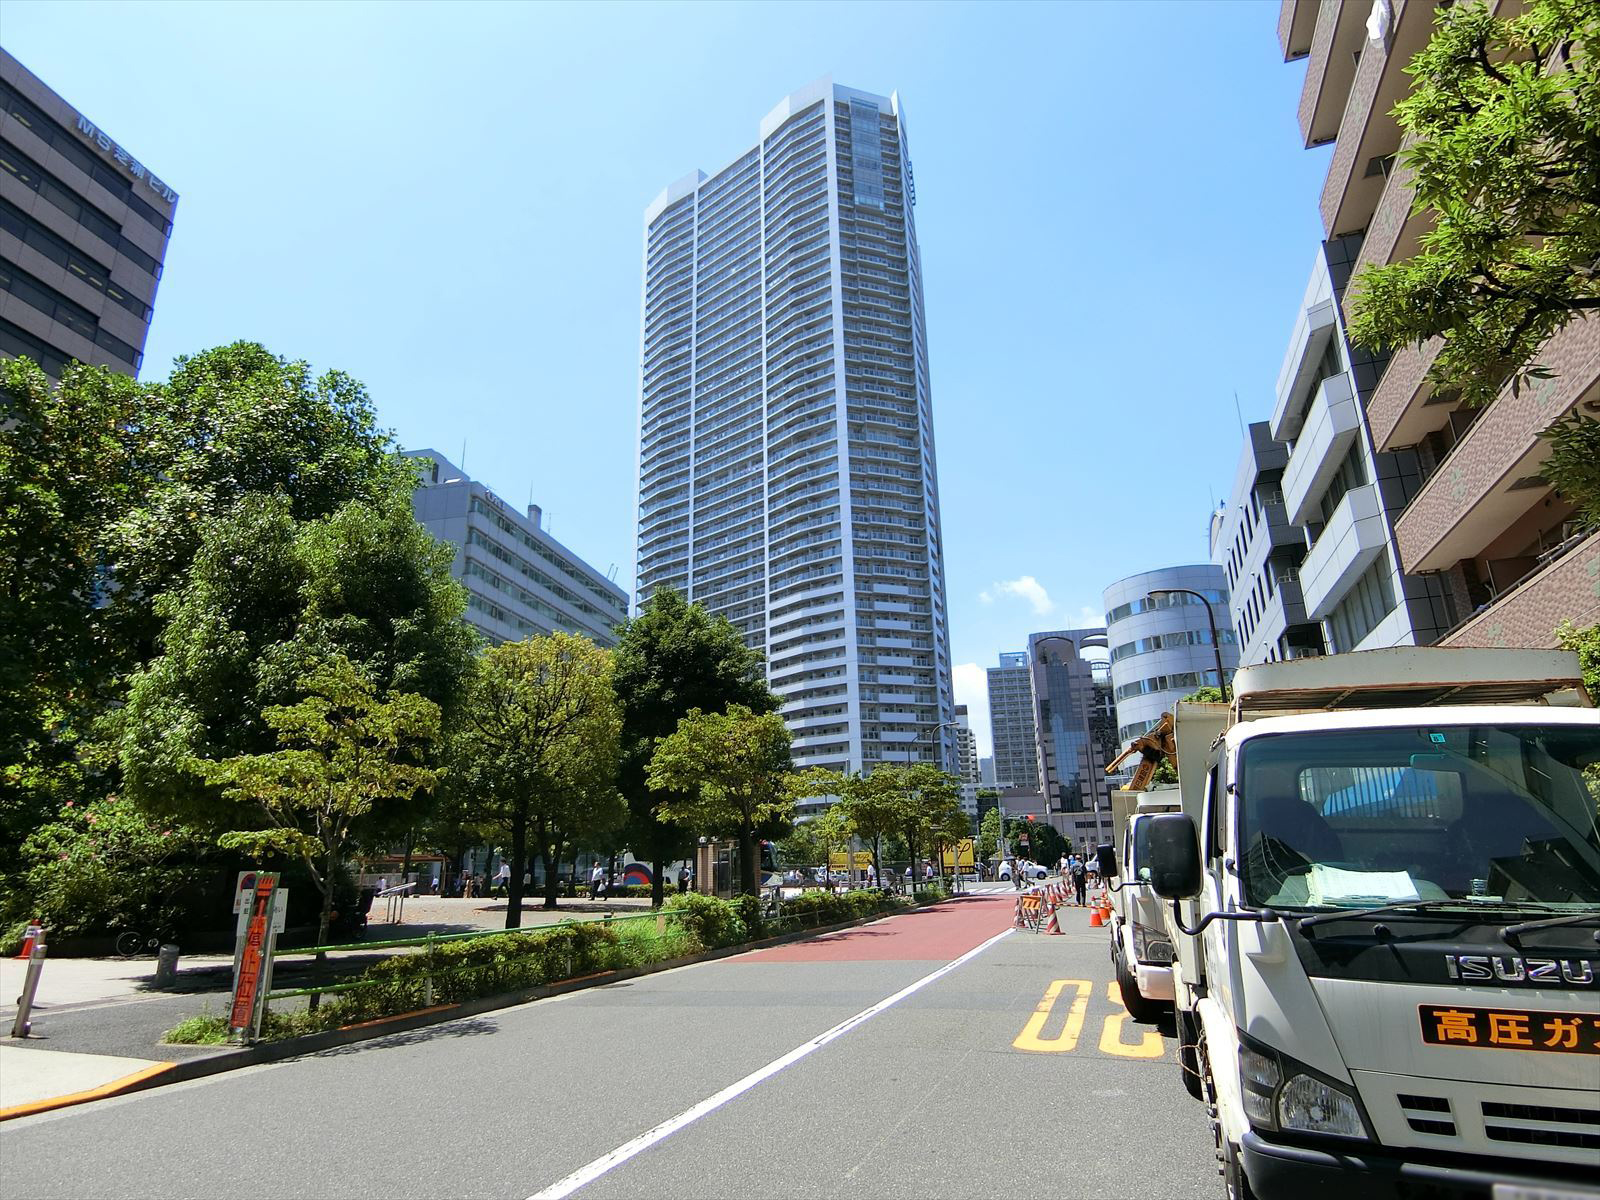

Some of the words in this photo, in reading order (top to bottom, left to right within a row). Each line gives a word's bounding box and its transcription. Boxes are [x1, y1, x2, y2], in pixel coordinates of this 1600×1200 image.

[1445, 954, 1594, 984] ISUZU
[1432, 1009, 1600, 1048] 高圧ガ
